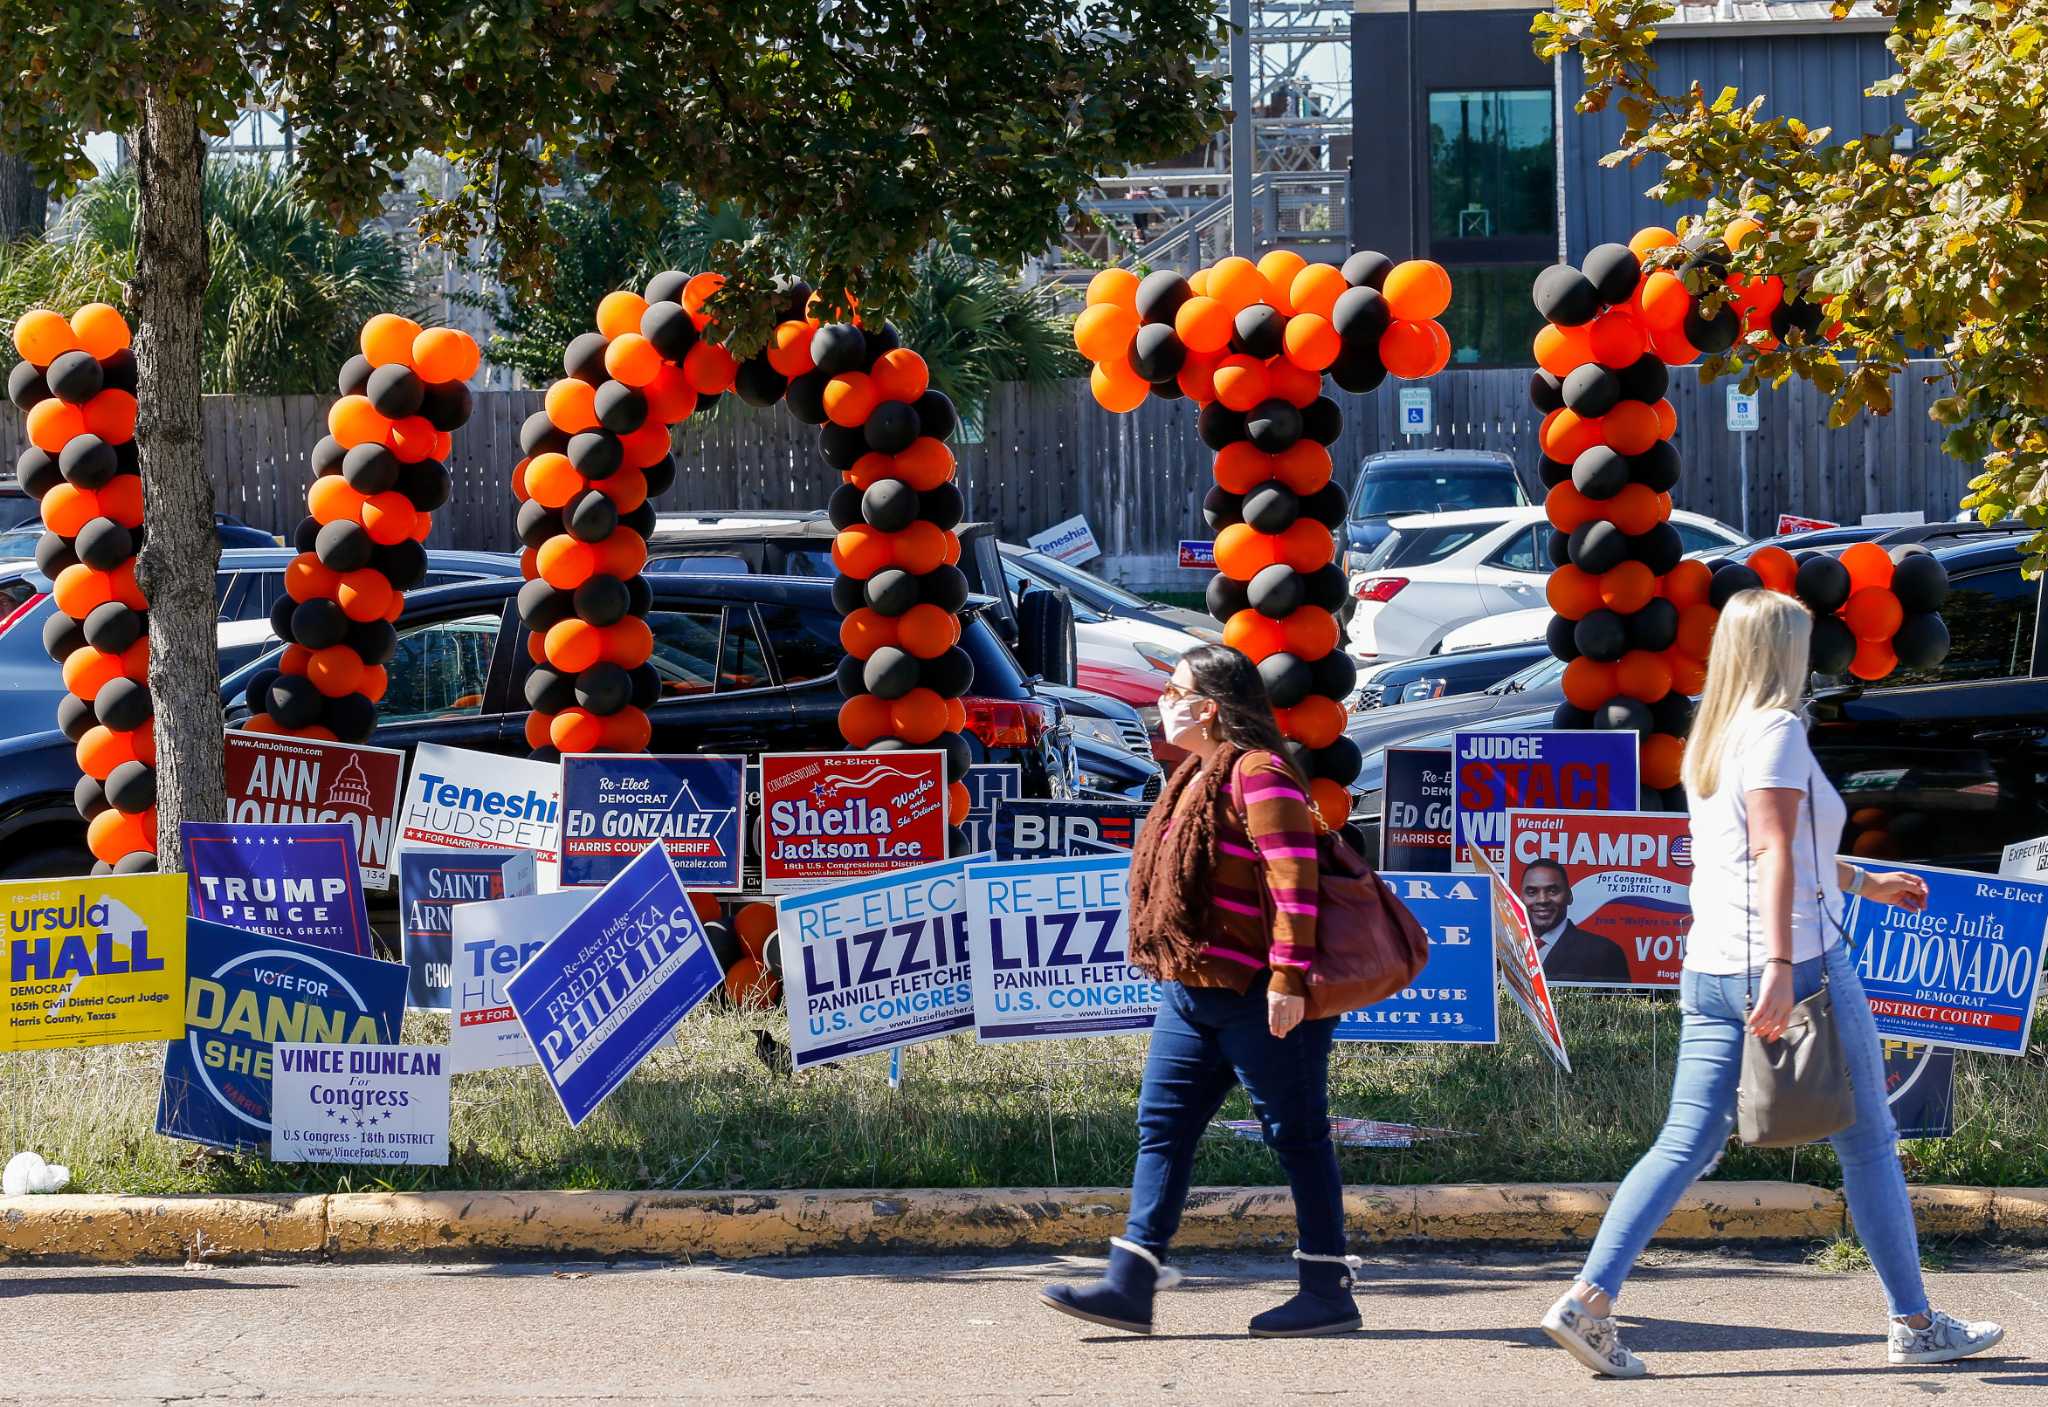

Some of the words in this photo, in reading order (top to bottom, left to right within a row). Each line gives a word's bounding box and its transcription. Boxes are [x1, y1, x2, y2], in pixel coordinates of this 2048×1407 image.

[1035, 526, 1088, 553] Teneshia
[230, 738, 323, 757] www.AnnJohnson.com
[1461, 737, 1543, 760] JUDGE
[824, 758, 881, 767] Re-Elect
[246, 755, 320, 803] ANN
[600, 778, 650, 790] Re-Elect
[767, 762, 821, 793] CONGRESSWOMAN
[1422, 770, 1452, 784] Re-E
[1459, 762, 1610, 811] STACI
[419, 773, 560, 823] Teneshi
[599, 794, 668, 804] DEMOCRAT
[891, 780, 935, 808] Works
[909, 796, 927, 810] and
[567, 809, 596, 837] ED
[602, 810, 713, 838] GONZALEZ
[771, 798, 892, 836] Sheila
[898, 816, 912, 828] She
[911, 801, 942, 819] Delivers
[1388, 801, 1418, 828] ED
[1424, 802, 1452, 830] GO
[1461, 811, 1505, 842] WI
[1517, 818, 1564, 830] Wendell
[425, 833, 444, 844] FOR
[446, 836, 480, 849] HARRIS
[1014, 814, 1147, 849] BIDE
[1392, 833, 1435, 844] HARRIS
[1437, 834, 1452, 845] CO
[569, 842, 612, 852] HARRIS
[664, 843, 710, 853] SHERIFF
[771, 838, 870, 860] Jackson
[878, 838, 922, 858] Lee
[1514, 831, 1693, 868] CHAMPI
[2008, 845, 2038, 861] EXPECT
[366, 869, 386, 880] 134
[807, 862, 825, 870] U.S.
[827, 861, 888, 871] Congressional
[200, 877, 346, 903] TRUMP
[429, 868, 489, 899] SAINT
[1597, 874, 1612, 884] for
[1614, 874, 1652, 885] Congress
[1608, 884, 1619, 892] TX
[1621, 884, 1659, 894] DISTRICT
[1662, 886, 1672, 894] 18
[12, 890, 61, 904] re-elect
[987, 873, 1129, 914] RE-ELE
[1976, 883, 2043, 904] Re-Elect
[11, 894, 109, 933] ursula
[221, 905, 329, 922] PENCE
[408, 900, 452, 931] ARN
[799, 874, 964, 942] RE-ELEC
[298, 926, 343, 935] GREAT!
[1880, 904, 1948, 938] Judge
[1951, 912, 2006, 941] Julia
[563, 938, 603, 978] Re-Elect
[602, 912, 631, 945] Judge
[989, 909, 1124, 970] LIZZ
[1635, 935, 1687, 962] VOT
[11, 930, 164, 982] HALL
[546, 904, 665, 1024] FREDERICKA
[254, 967, 294, 990] VOTE
[297, 978, 328, 998] FOR
[425, 962, 452, 988] CHO
[540, 906, 693, 1070] PHILLIPS
[994, 968, 1075, 990] PANNILL
[1656, 970, 1680, 980] #toge
[10, 983, 72, 996] DEMOCRAT
[11, 1001, 39, 1012] 165th
[43, 999, 65, 1010] Civil
[69, 995, 104, 1008] District
[107, 994, 135, 1006] Court
[138, 992, 169, 1005] Judge
[808, 984, 885, 1015] PANNILL
[891, 965, 971, 996] FLETCHE
[994, 992, 1041, 1012] U.S.
[1047, 984, 1162, 1009] CONGRES
[1915, 989, 1988, 1008] DEMOCRAT
[10, 1016, 41, 1028] Harris
[45, 1013, 83, 1026] County,
[87, 1010, 116, 1022] Texas
[184, 976, 379, 1045] DANNA
[487, 1010, 511, 1021] FOR
[575, 1042, 597, 1065] 61st
[596, 1016, 619, 1043] Civil
[618, 985, 653, 1020] District
[653, 957, 682, 985] Court
[809, 1011, 852, 1036] U.S.
[859, 984, 973, 1024] CONGRES
[889, 1005, 975, 1030] www.lizziefletcher.c
[1078, 1004, 1158, 1018] www.lizziefletche
[1340, 1011, 1421, 1024] TRICT
[1429, 1012, 1464, 1025] 133
[1869, 1001, 1937, 1020] DISTRICT
[1940, 1009, 1992, 1027] COURT
[204, 1041, 272, 1081] SHE
[280, 1049, 343, 1074] VINCE
[350, 1051, 441, 1076] DUNCAN
[349, 1076, 371, 1087] For
[310, 1084, 409, 1111] Congress
[283, 1130, 300, 1142] U.S
[303, 1130, 350, 1144] Congress
[360, 1132, 384, 1145] 18th
[388, 1132, 434, 1146] DISTRICT
[308, 1146, 409, 1160] www.VinceForUS.com
